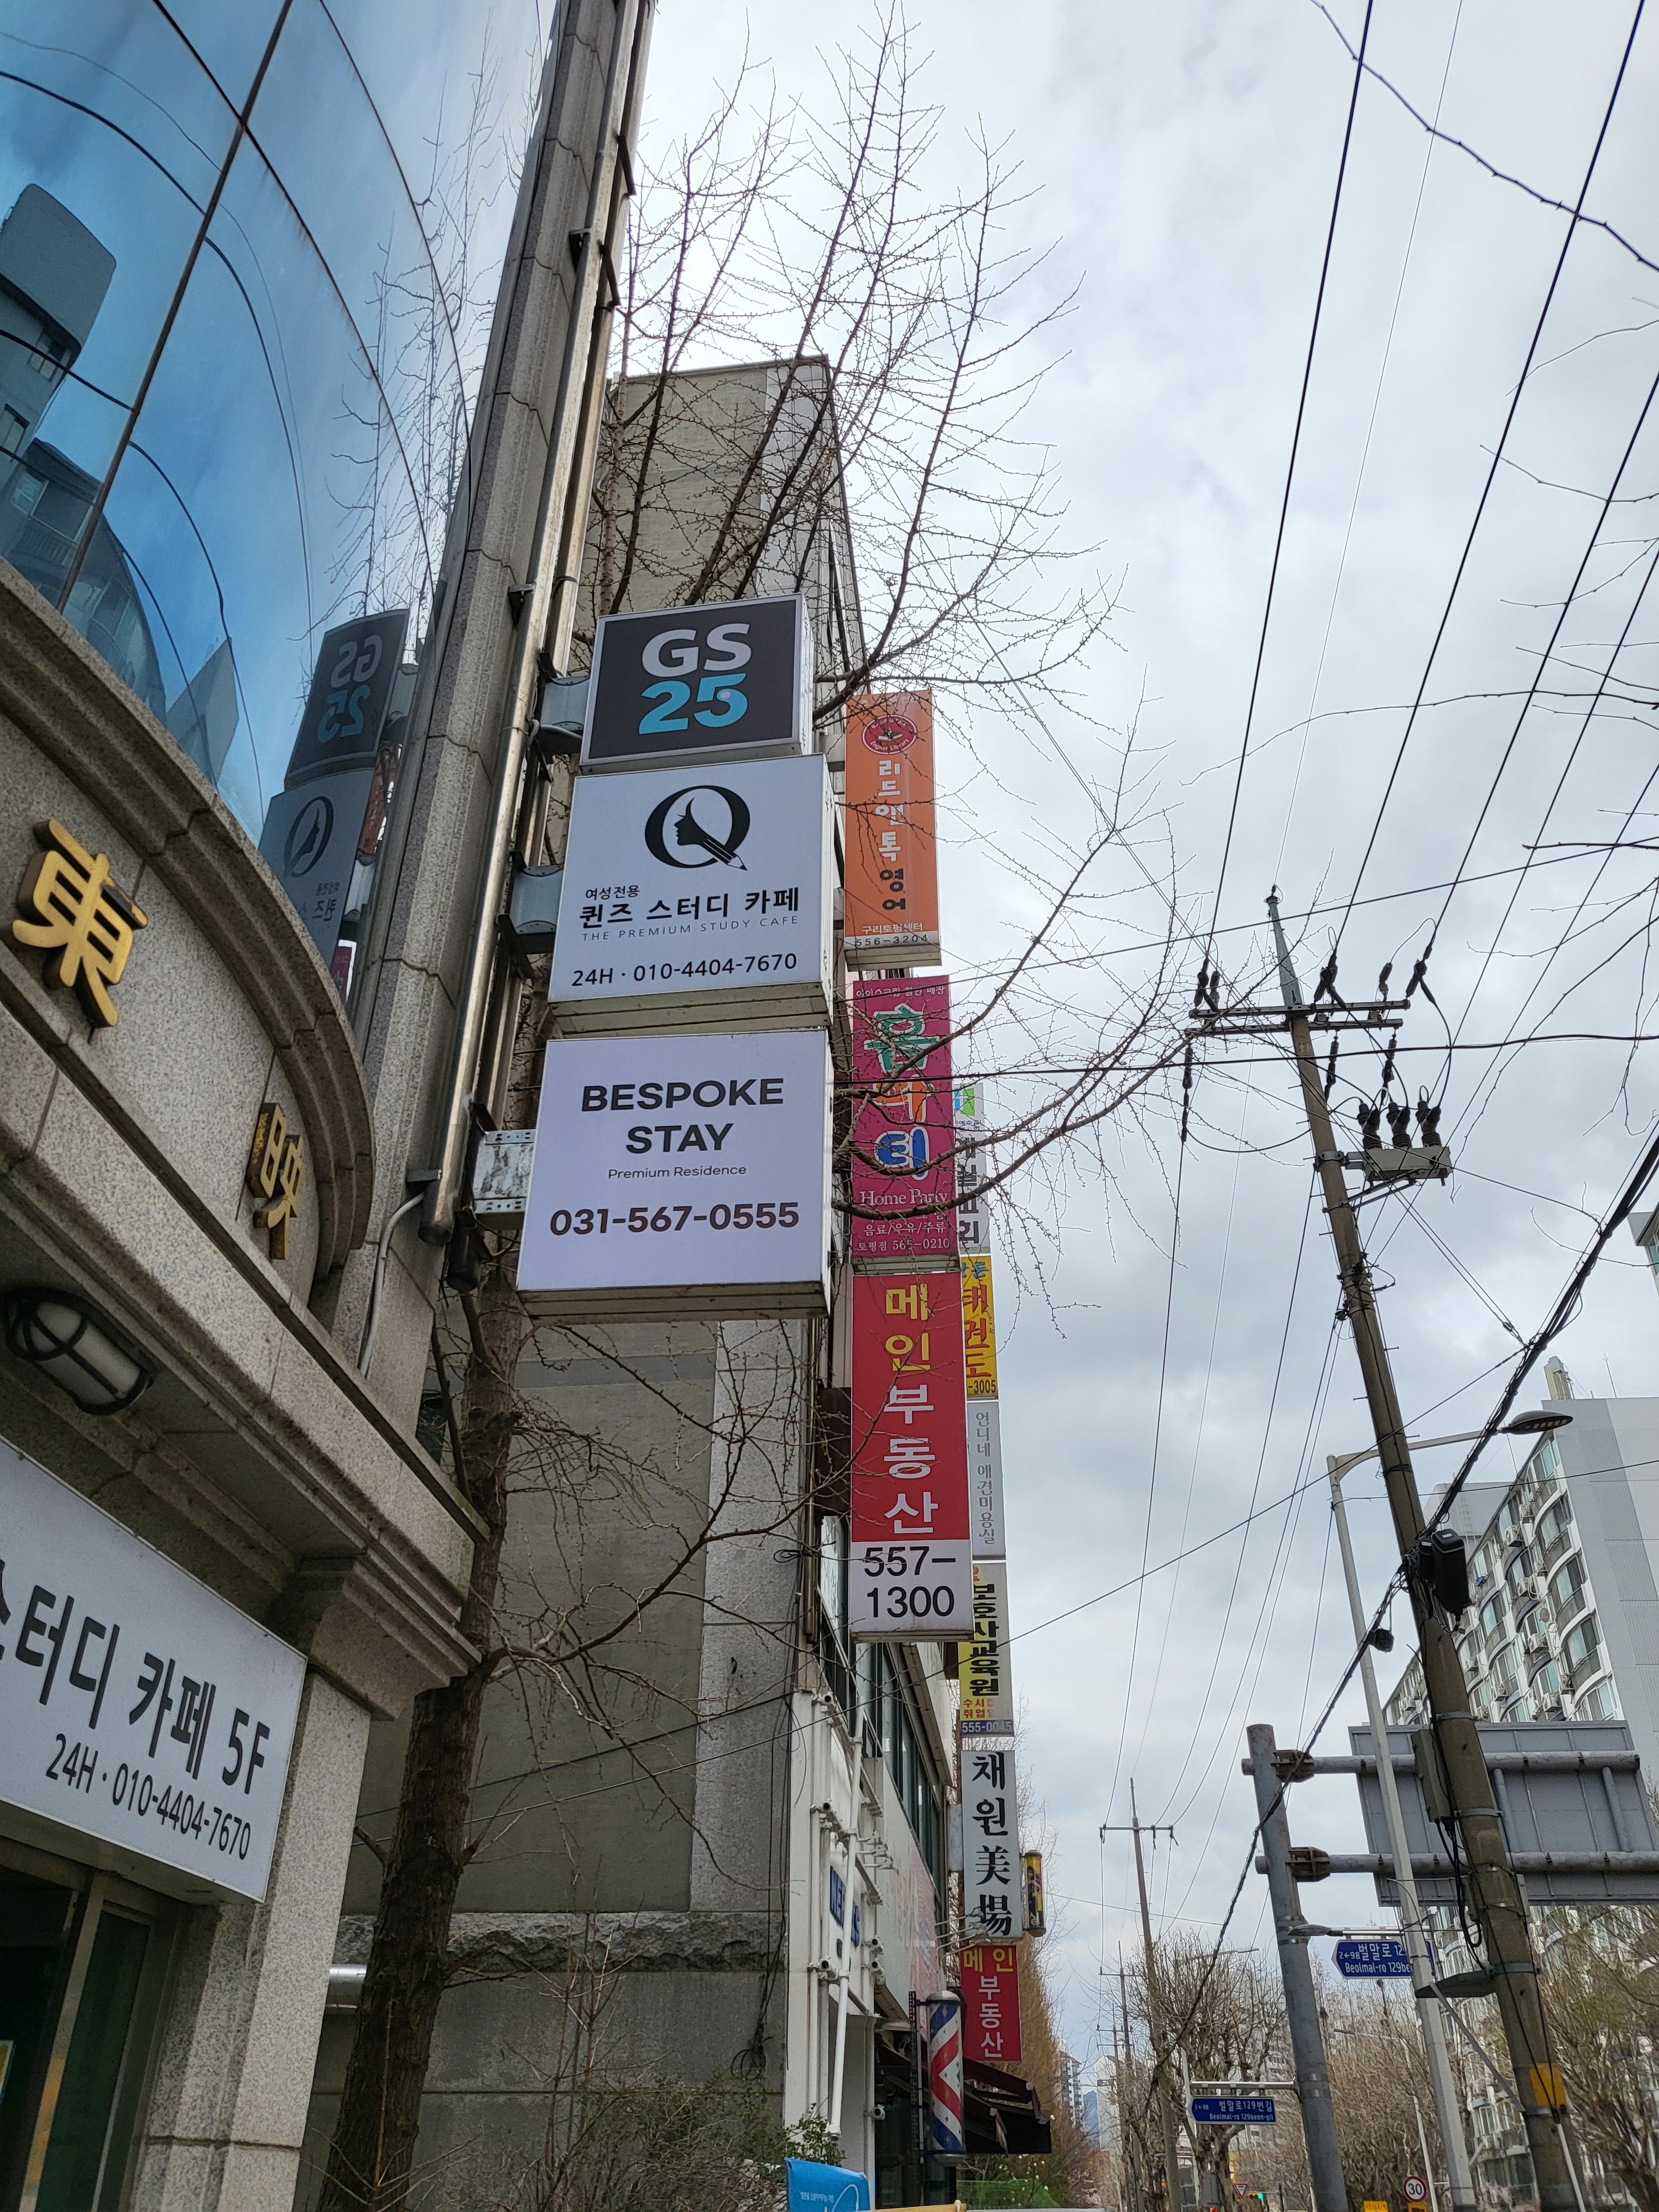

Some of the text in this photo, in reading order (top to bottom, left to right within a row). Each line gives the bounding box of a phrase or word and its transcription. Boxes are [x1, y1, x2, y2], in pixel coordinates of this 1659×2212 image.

[642, 623, 752, 677] GS
[639, 672, 749, 734] 25
[585, 885, 640, 901] 여성전용
[879, 868, 906, 910] 영어
[580, 887, 799, 929] 퀸즈 스터디 카페
[582, 915, 799, 942] THE PREMIUM STUDY CAFE
[855, 934, 928, 947] 556-3204
[571, 953, 797, 987] 24H 010-4404-7670
[927, 985, 946, 995] 매장
[581, 1078, 784, 1112] BESPOKE
[625, 1123, 734, 1154] STAY
[608, 1165, 747, 1180] Premium Residence
[859, 1188, 948, 1206] Home Party
[550, 1202, 800, 1236] 031-567-0555
[867, 1585, 955, 1619] 1300
[0, 1559, 270, 1795] 터디 카페 5F
[46, 1733, 251, 1860] 24H 010-4404-7670
[1345, 1961, 1413, 1973] Beolmal-ro 129be
[979, 1975, 1004, 2058] 부동산
[1408, 2183, 1422, 2195] 30
